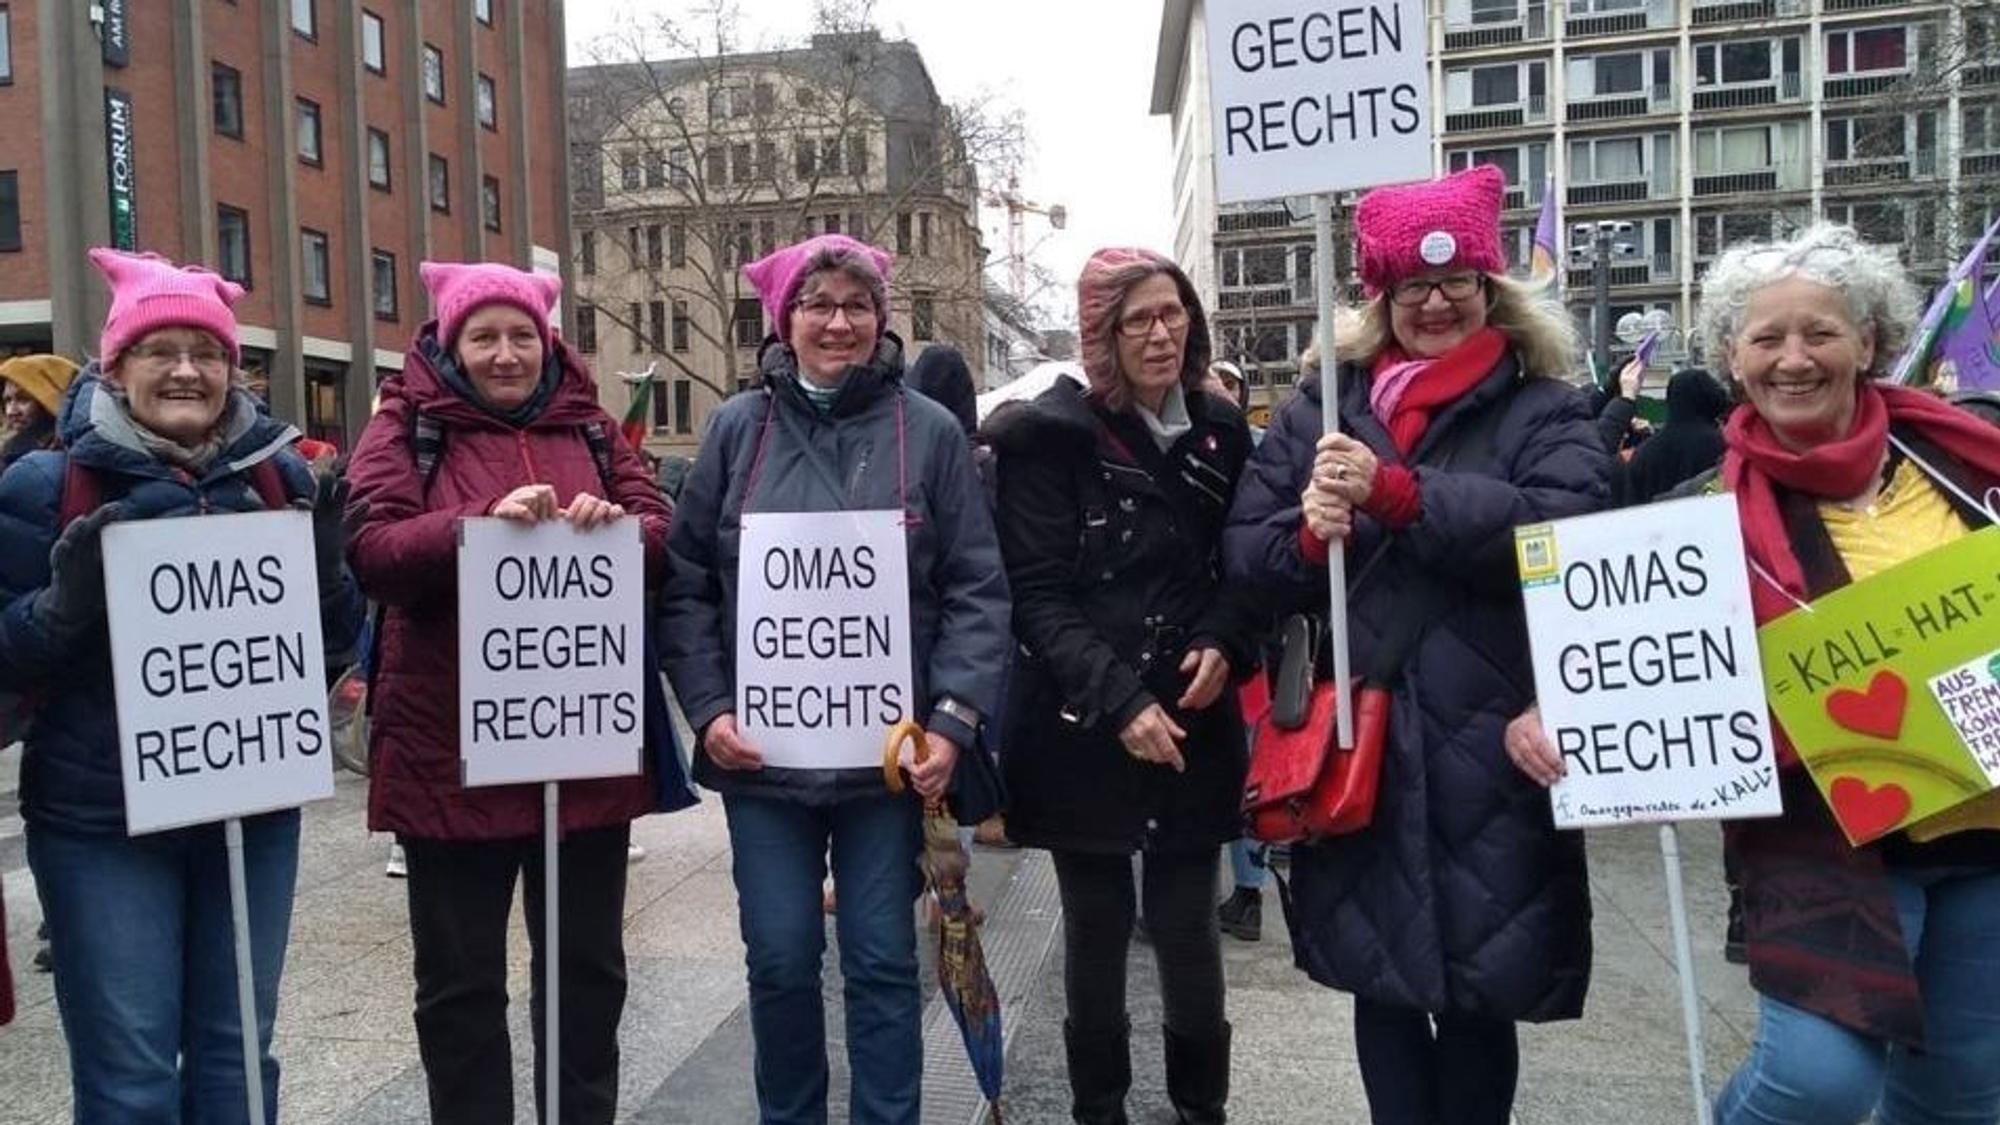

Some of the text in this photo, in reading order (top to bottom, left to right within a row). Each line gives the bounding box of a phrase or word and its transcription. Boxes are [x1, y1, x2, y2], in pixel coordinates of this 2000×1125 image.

[1231, 2, 1402, 73] GEGEN
[109, 98, 129, 192] FORUM
[1225, 83, 1420, 156] RECHTS
[150, 555, 285, 615] OMAS
[495, 554, 614, 601] OMAS
[763, 545, 876, 590] OMAS
[1564, 544, 1708, 612] OMAS
[141, 631, 305, 698] GEGEN
[482, 623, 626, 672] GEGEN
[752, 615, 890, 659] GEGEN
[1558, 625, 1738, 695] GEGEN
[745, 683, 903, 729] RECHTS
[1936, 668, 1977, 698] AUS
[135, 708, 323, 782] RECHTS
[473, 691, 636, 743] RECHTS
[1556, 710, 1763, 778] RECHTS
